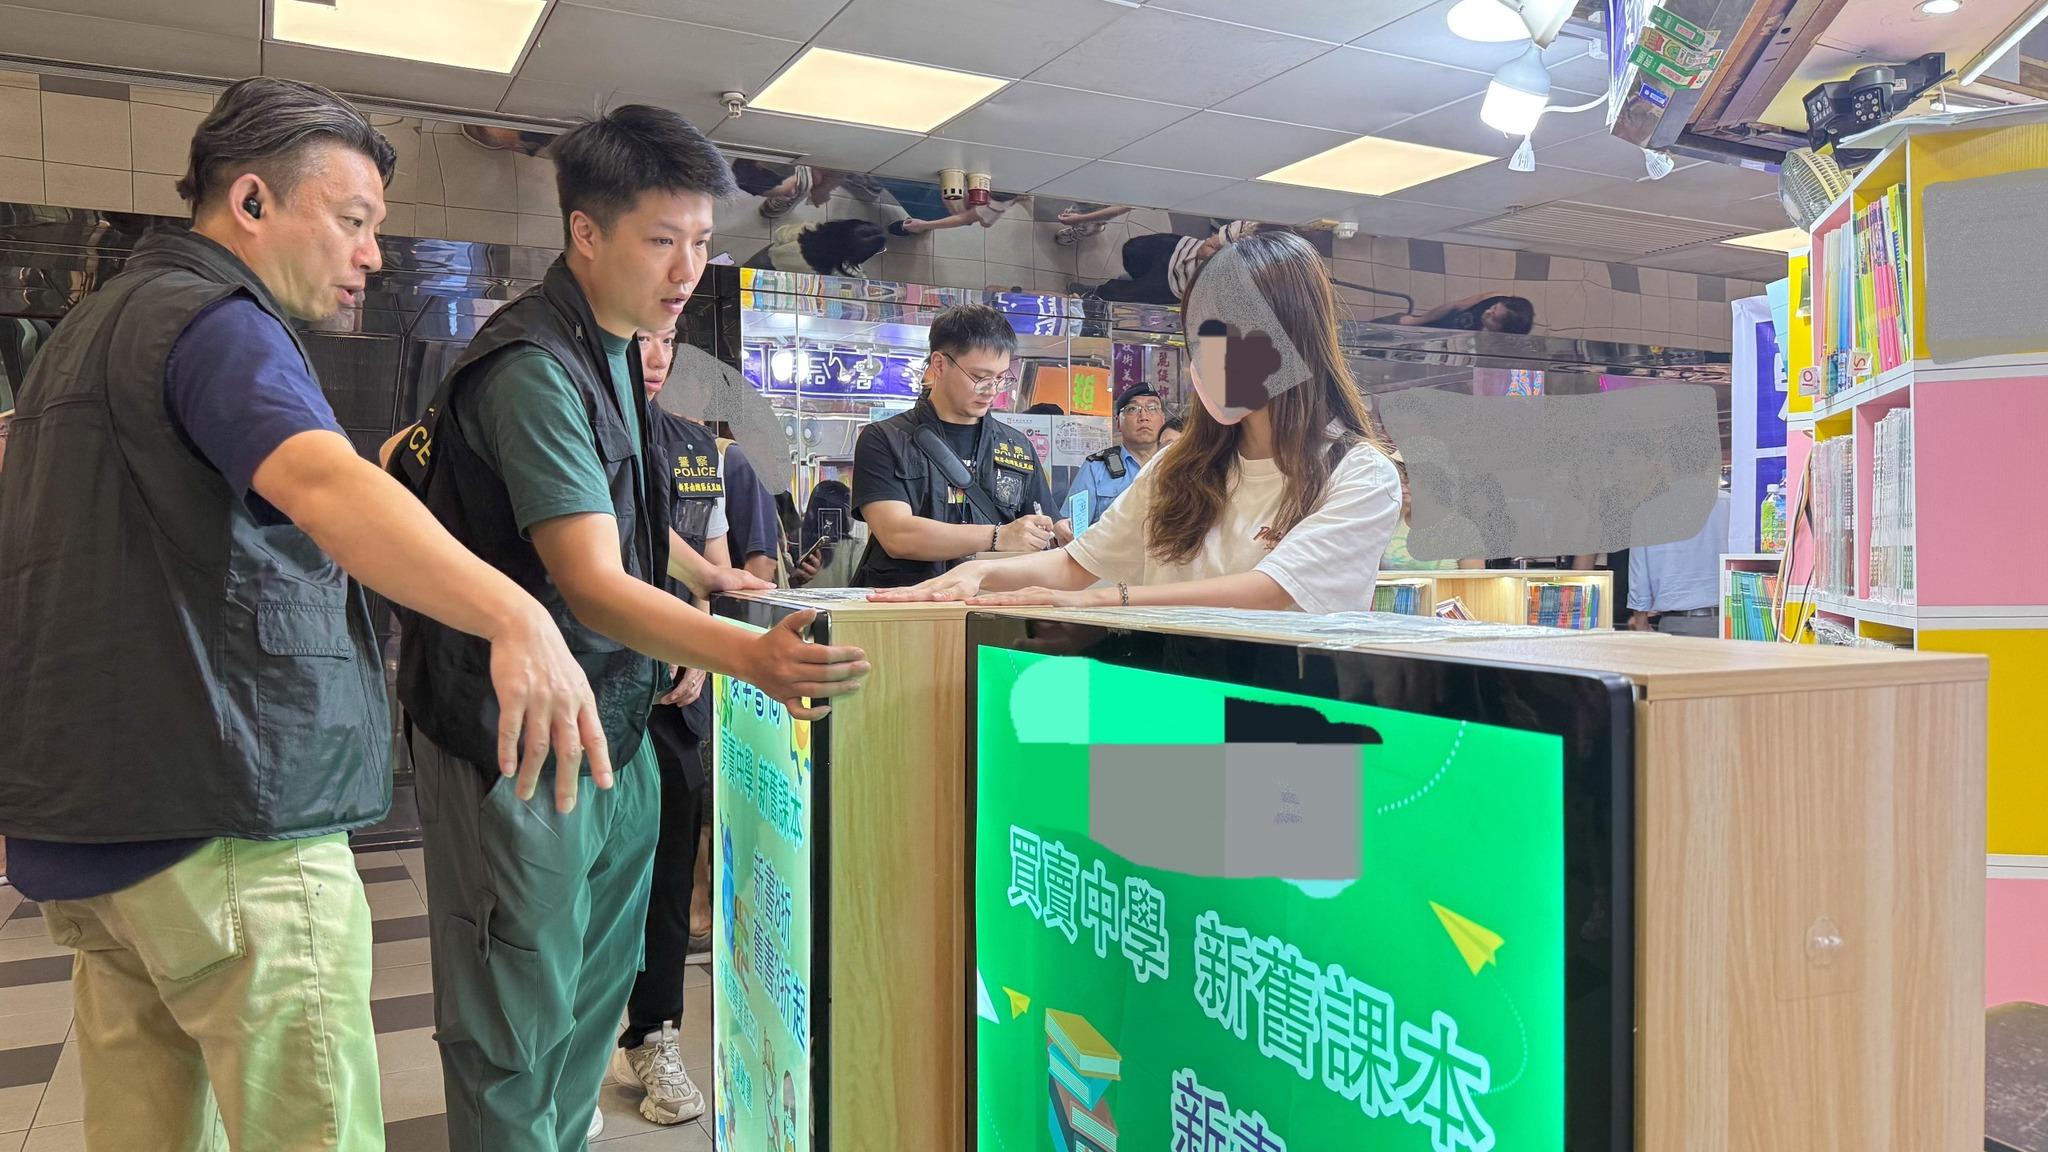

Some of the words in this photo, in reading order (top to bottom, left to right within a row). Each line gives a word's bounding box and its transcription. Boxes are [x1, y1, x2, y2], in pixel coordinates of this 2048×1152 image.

[678, 456, 708, 467] 警察
[674, 467, 716, 477] POLICE
[1009, 824, 1169, 982] 買賣中學
[1194, 909, 1495, 1152] 新舊課本
